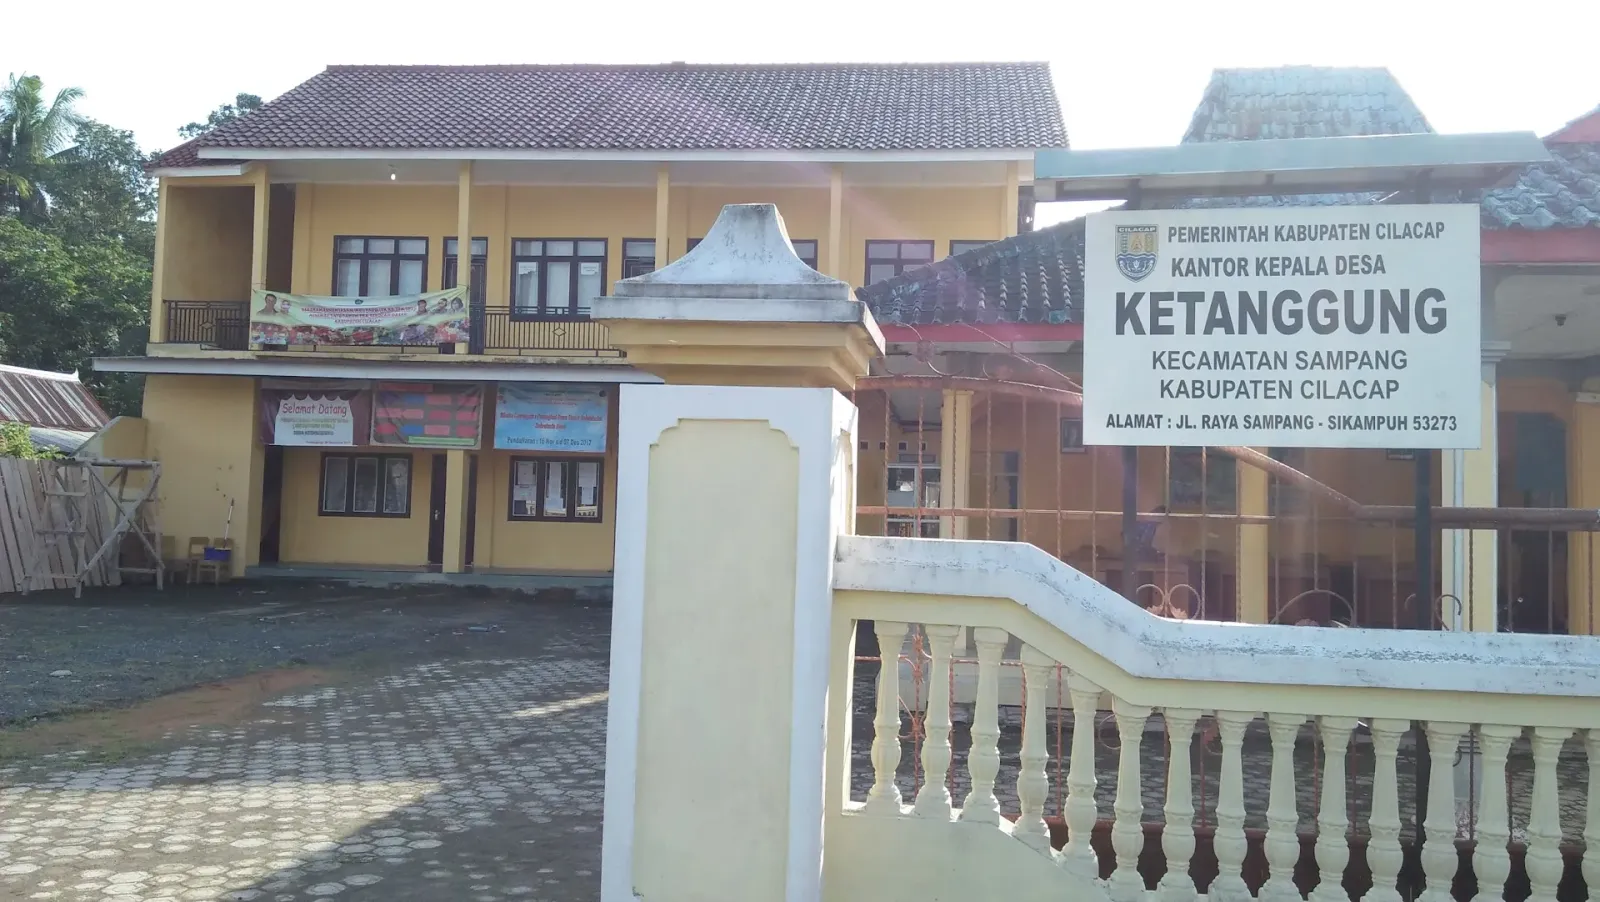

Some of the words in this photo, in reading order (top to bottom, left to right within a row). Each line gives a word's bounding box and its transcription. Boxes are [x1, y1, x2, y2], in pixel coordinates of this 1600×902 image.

[1168, 226, 1269, 243] PEMERINTAH
[1274, 223, 1370, 242] KABUPATEN
[1375, 222, 1445, 240] CILACAP
[1171, 257, 1250, 278] KANTOR
[1255, 256, 1329, 277] KEPALA
[1335, 254, 1387, 276] DESA
[1115, 288, 1447, 336] KETANGGUNG
[1152, 350, 1288, 371] KECAMATAN
[1295, 349, 1408, 371] SAMPANG
[1160, 379, 1293, 400] KABUPATEN
[1300, 379, 1400, 400] CILACAP
[282, 402, 315, 414] Selamat
[318, 404, 347, 418] Datang
[1105, 413, 1164, 429] ALAMAT
[1175, 414, 1197, 430] JL.
[1201, 414, 1239, 430] RAYA
[1243, 414, 1314, 430] SAMPANG
[1327, 415, 1408, 431] SIKAMPUH
[1412, 415, 1457, 431] 53273
